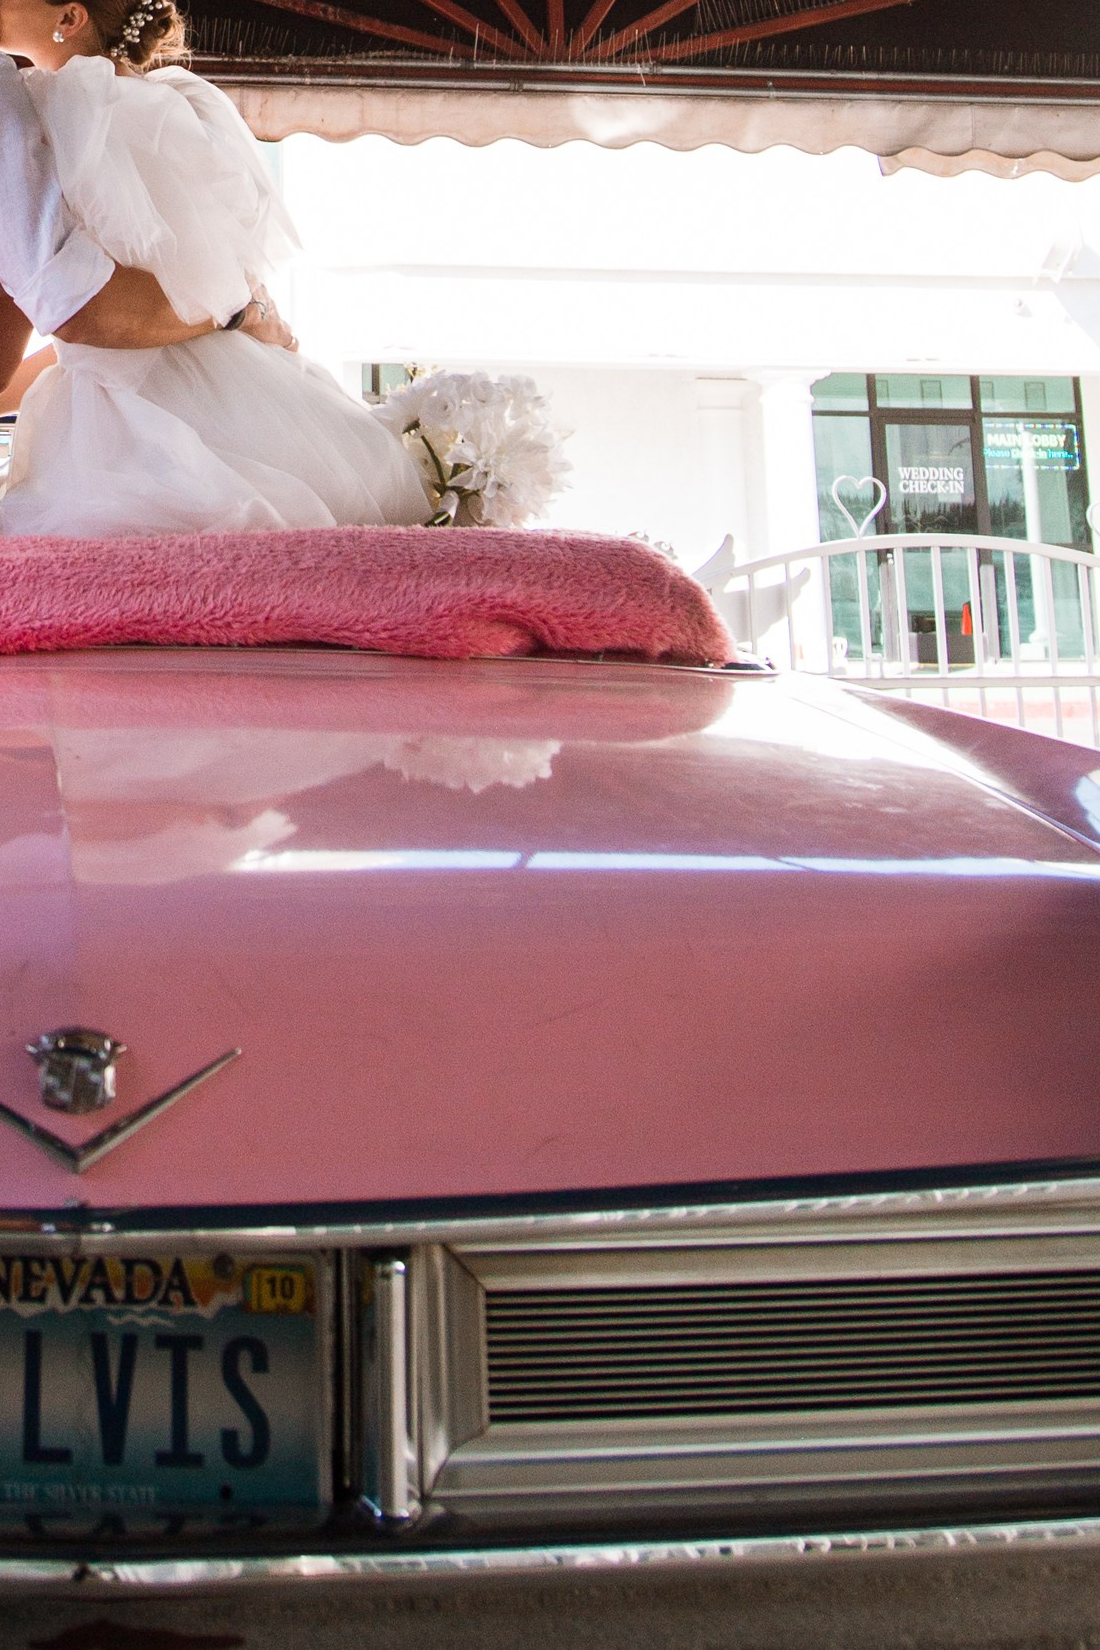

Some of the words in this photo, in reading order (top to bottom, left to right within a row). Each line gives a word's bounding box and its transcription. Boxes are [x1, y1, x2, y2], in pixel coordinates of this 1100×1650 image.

[986, 433, 1021, 447] MAIN
[1011, 448, 1047, 459] Chk-in
[898, 467, 964, 480] WEDDING
[899, 480, 965, 494] CHECK-IN
[265, 1275, 295, 1300] 10
[22, 1329, 271, 1471] LVIS
